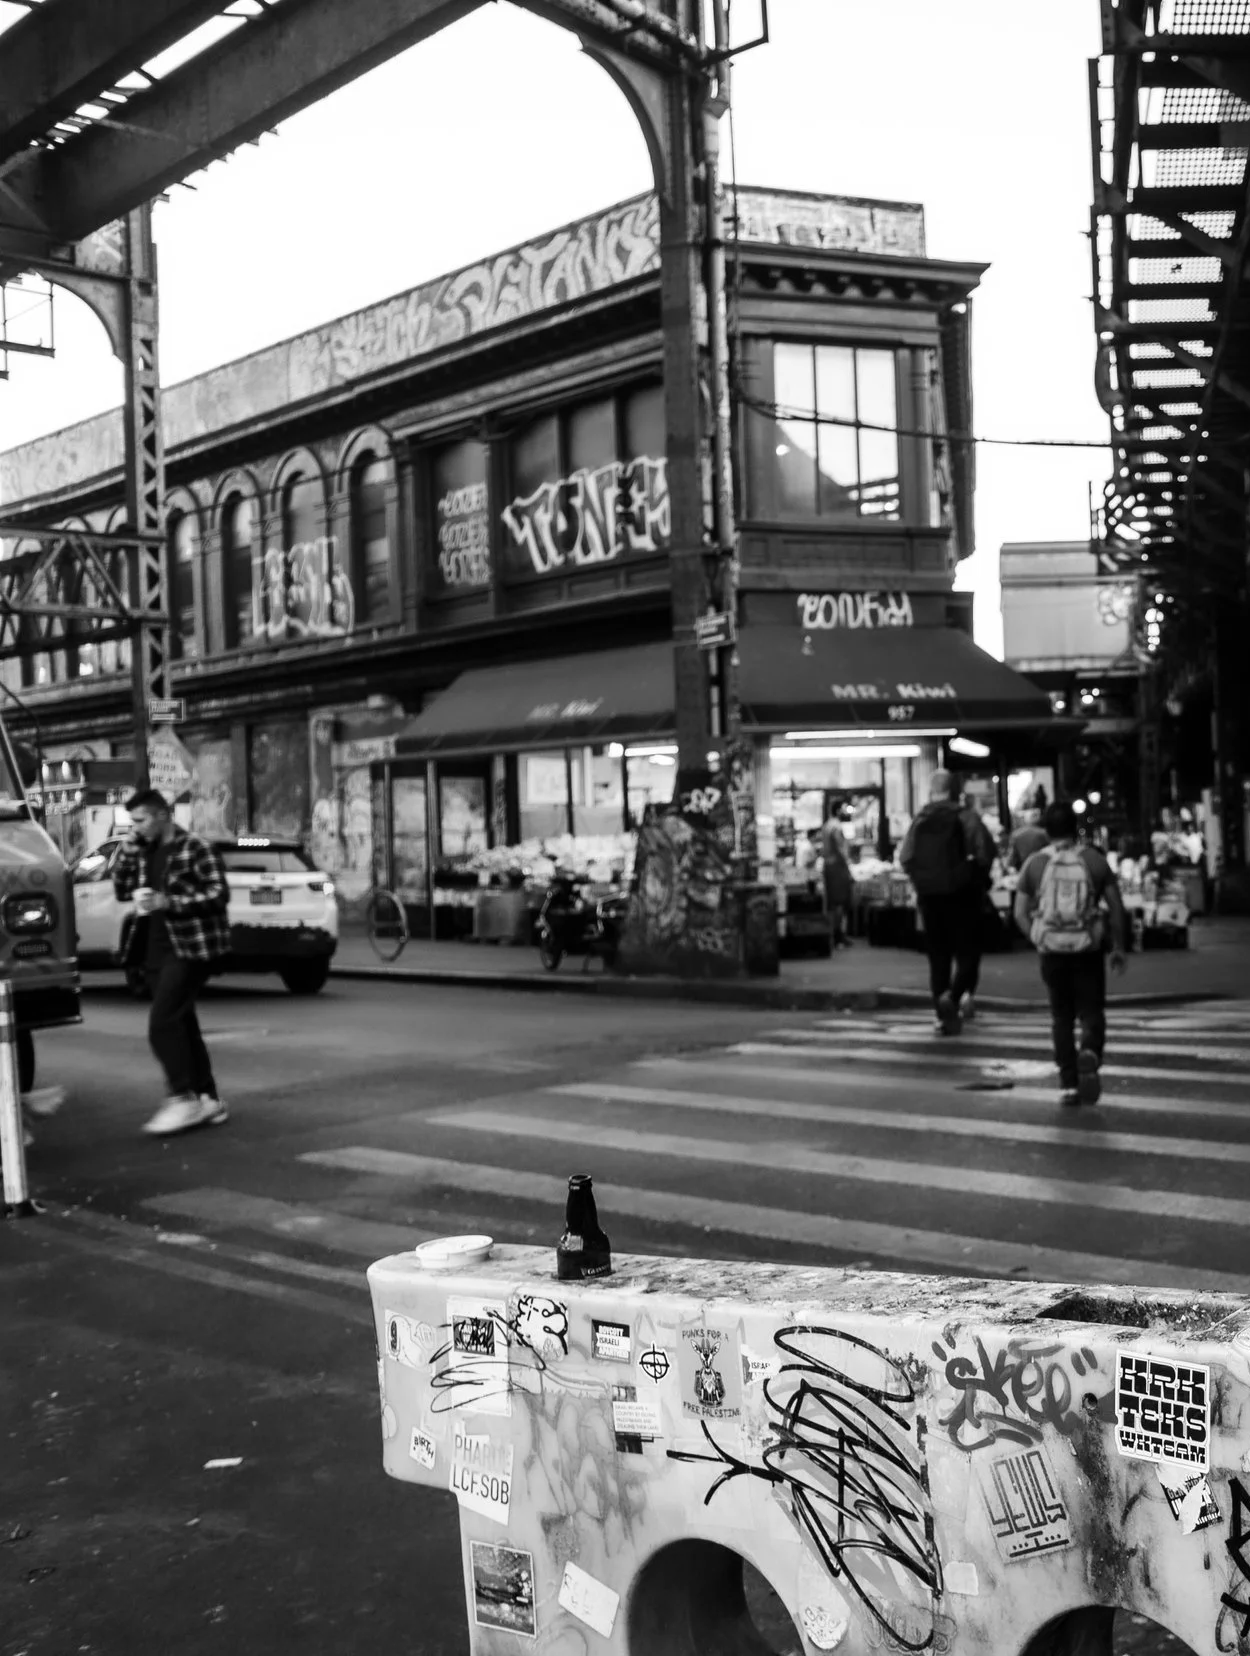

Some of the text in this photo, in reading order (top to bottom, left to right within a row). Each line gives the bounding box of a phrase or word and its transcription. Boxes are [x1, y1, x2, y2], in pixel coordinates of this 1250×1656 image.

[682, 1328, 704, 1339] PUNKS
[707, 1329, 721, 1339] FOR
[683, 1401, 700, 1415] FREE
